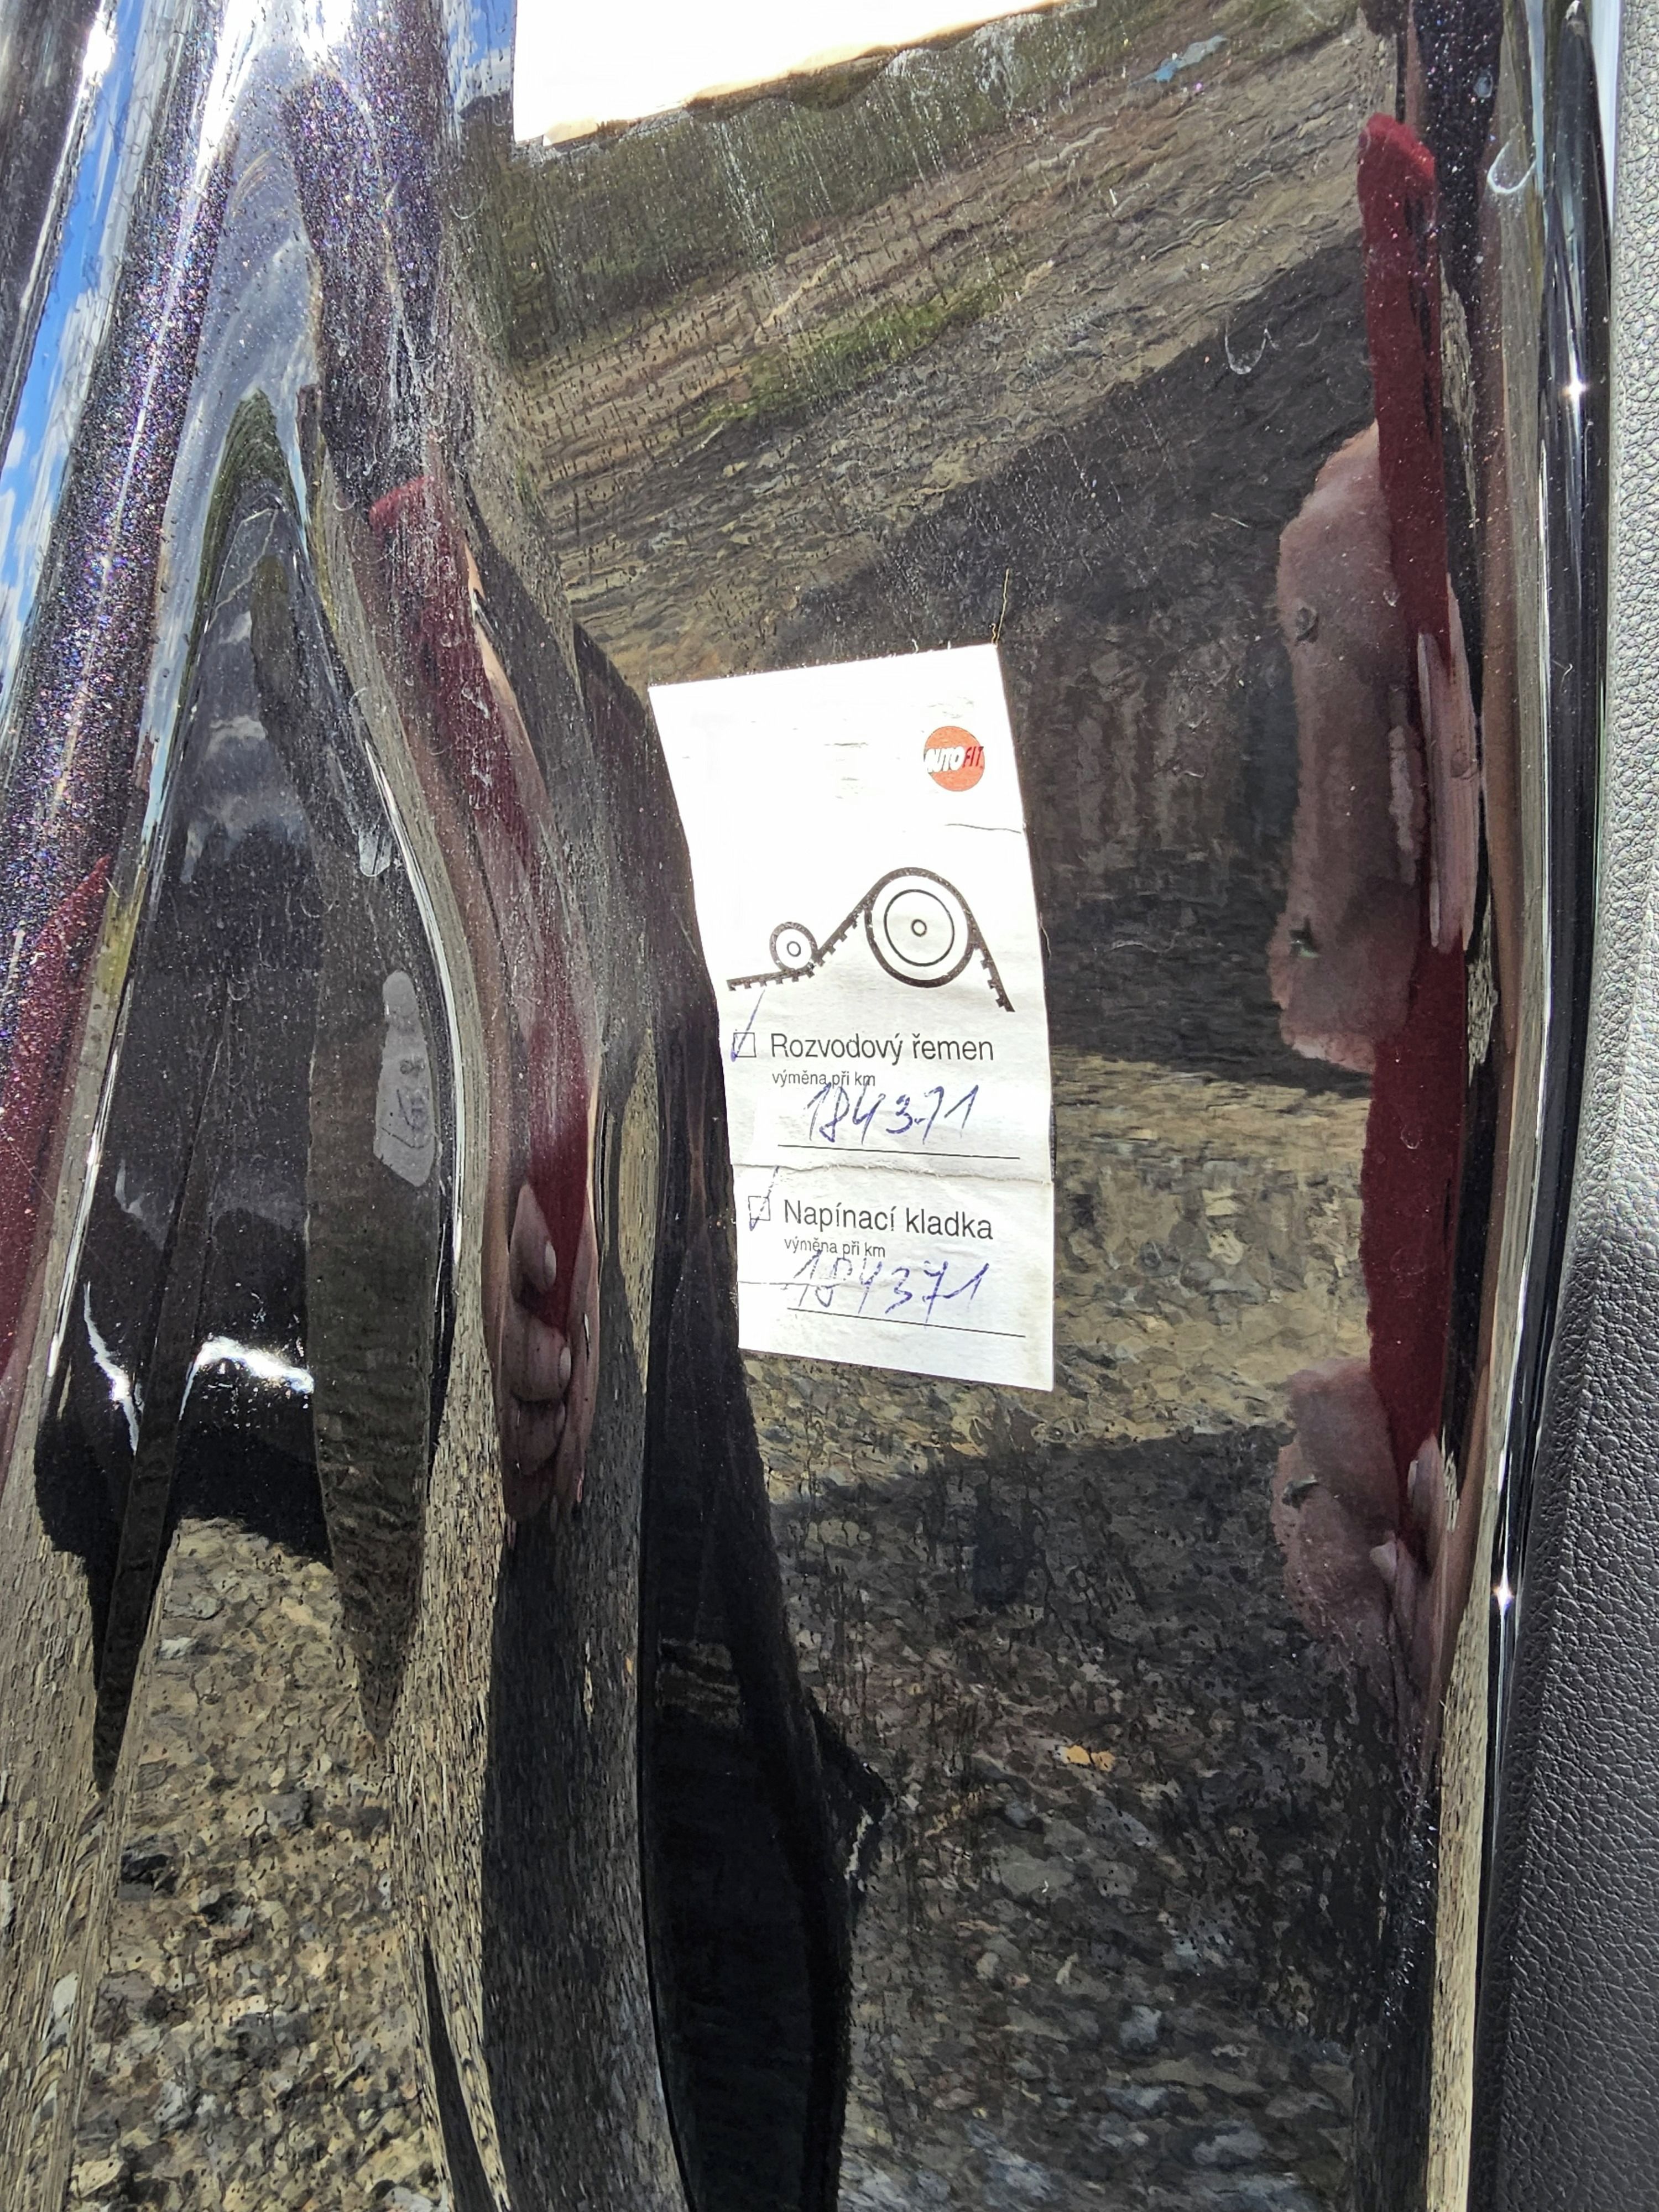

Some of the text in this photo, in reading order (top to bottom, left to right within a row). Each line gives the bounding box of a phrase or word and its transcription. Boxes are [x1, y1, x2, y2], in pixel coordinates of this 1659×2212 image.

[770, 1032, 994, 1066] Rozvodový řemen
[772, 1071, 876, 1087] výměna při km
[784, 1199, 994, 1240] Napínací kladka
[784, 1238, 886, 1258] výměna při km
